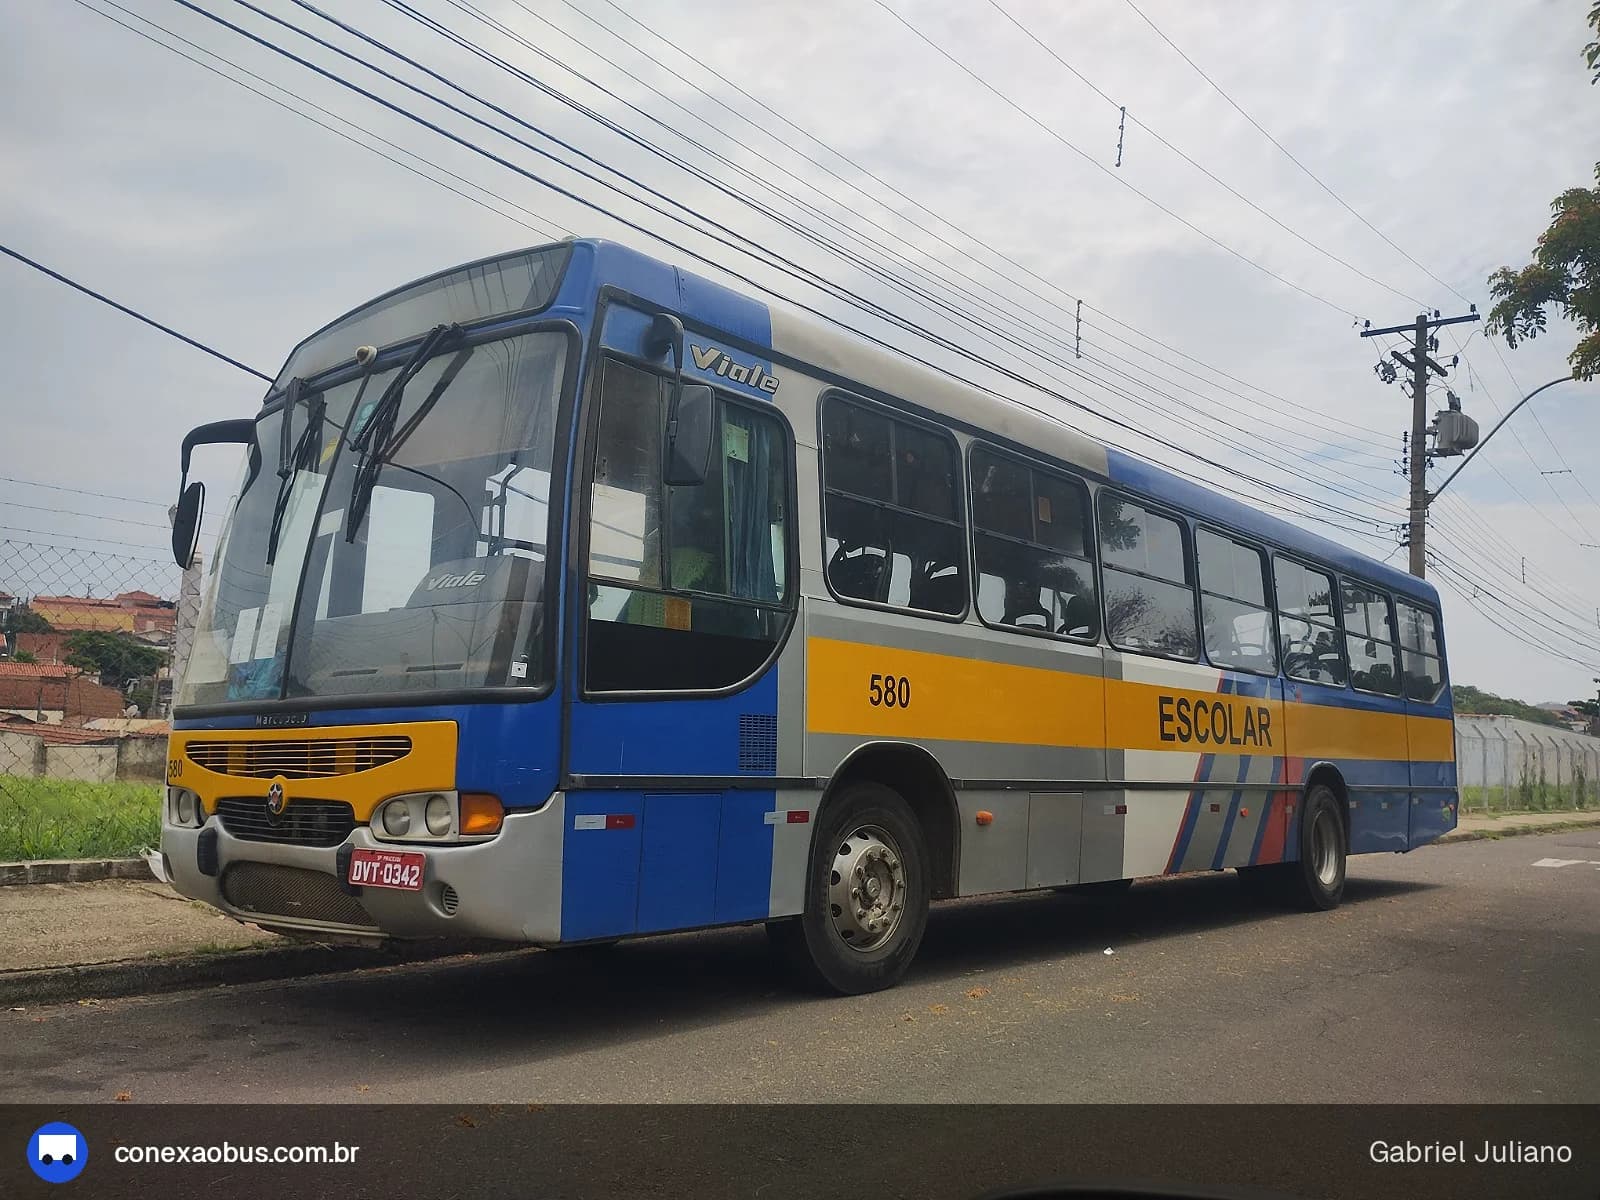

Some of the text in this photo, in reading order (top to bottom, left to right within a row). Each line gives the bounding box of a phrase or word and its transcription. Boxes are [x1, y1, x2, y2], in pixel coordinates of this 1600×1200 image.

[690, 343, 779, 394] Viale
[427, 570, 486, 591] Viale
[869, 673, 910, 708] 580
[1158, 695, 1272, 747] ESCOLAR
[168, 759, 183, 777] 580
